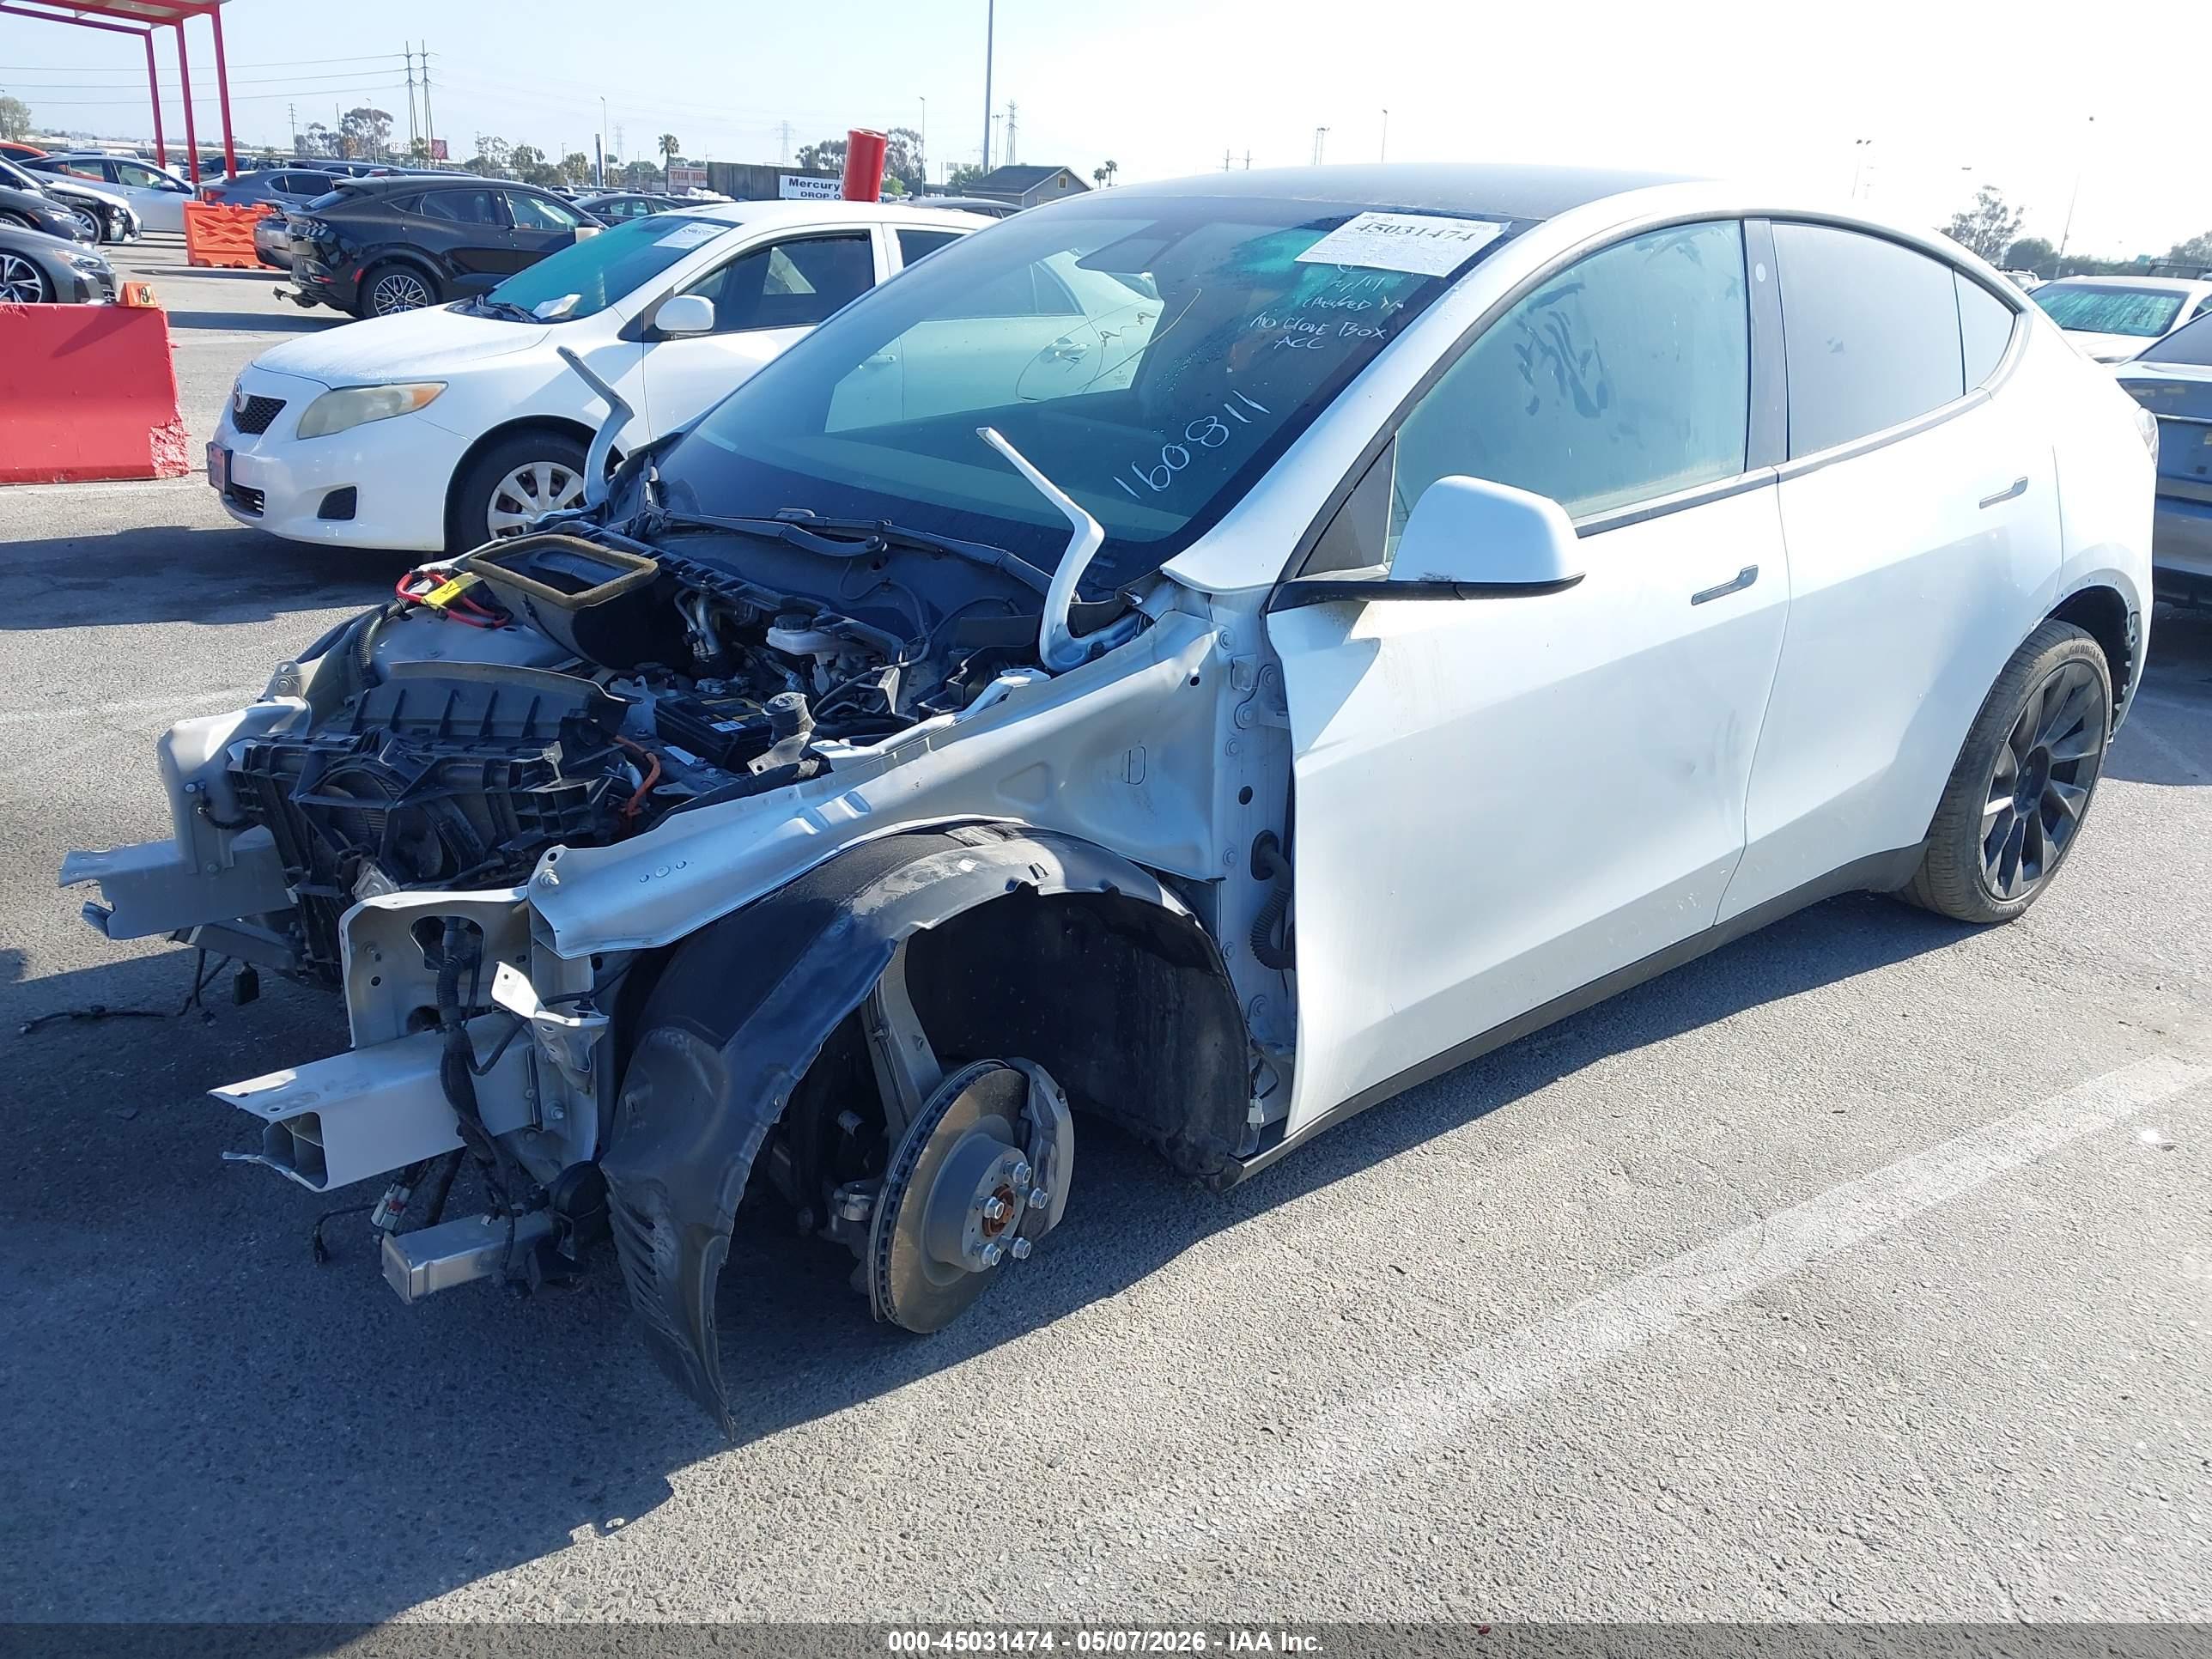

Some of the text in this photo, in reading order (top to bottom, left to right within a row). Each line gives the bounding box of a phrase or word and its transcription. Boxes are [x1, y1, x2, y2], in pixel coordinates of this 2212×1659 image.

[788, 178, 841, 191] Mercury
[800, 191, 830, 199] DROP
[1355, 222, 1476, 241] 45031474
[1249, 311, 1277, 328] NO
[1273, 336, 1325, 350] ACC
[1113, 389, 1271, 500] 160811
